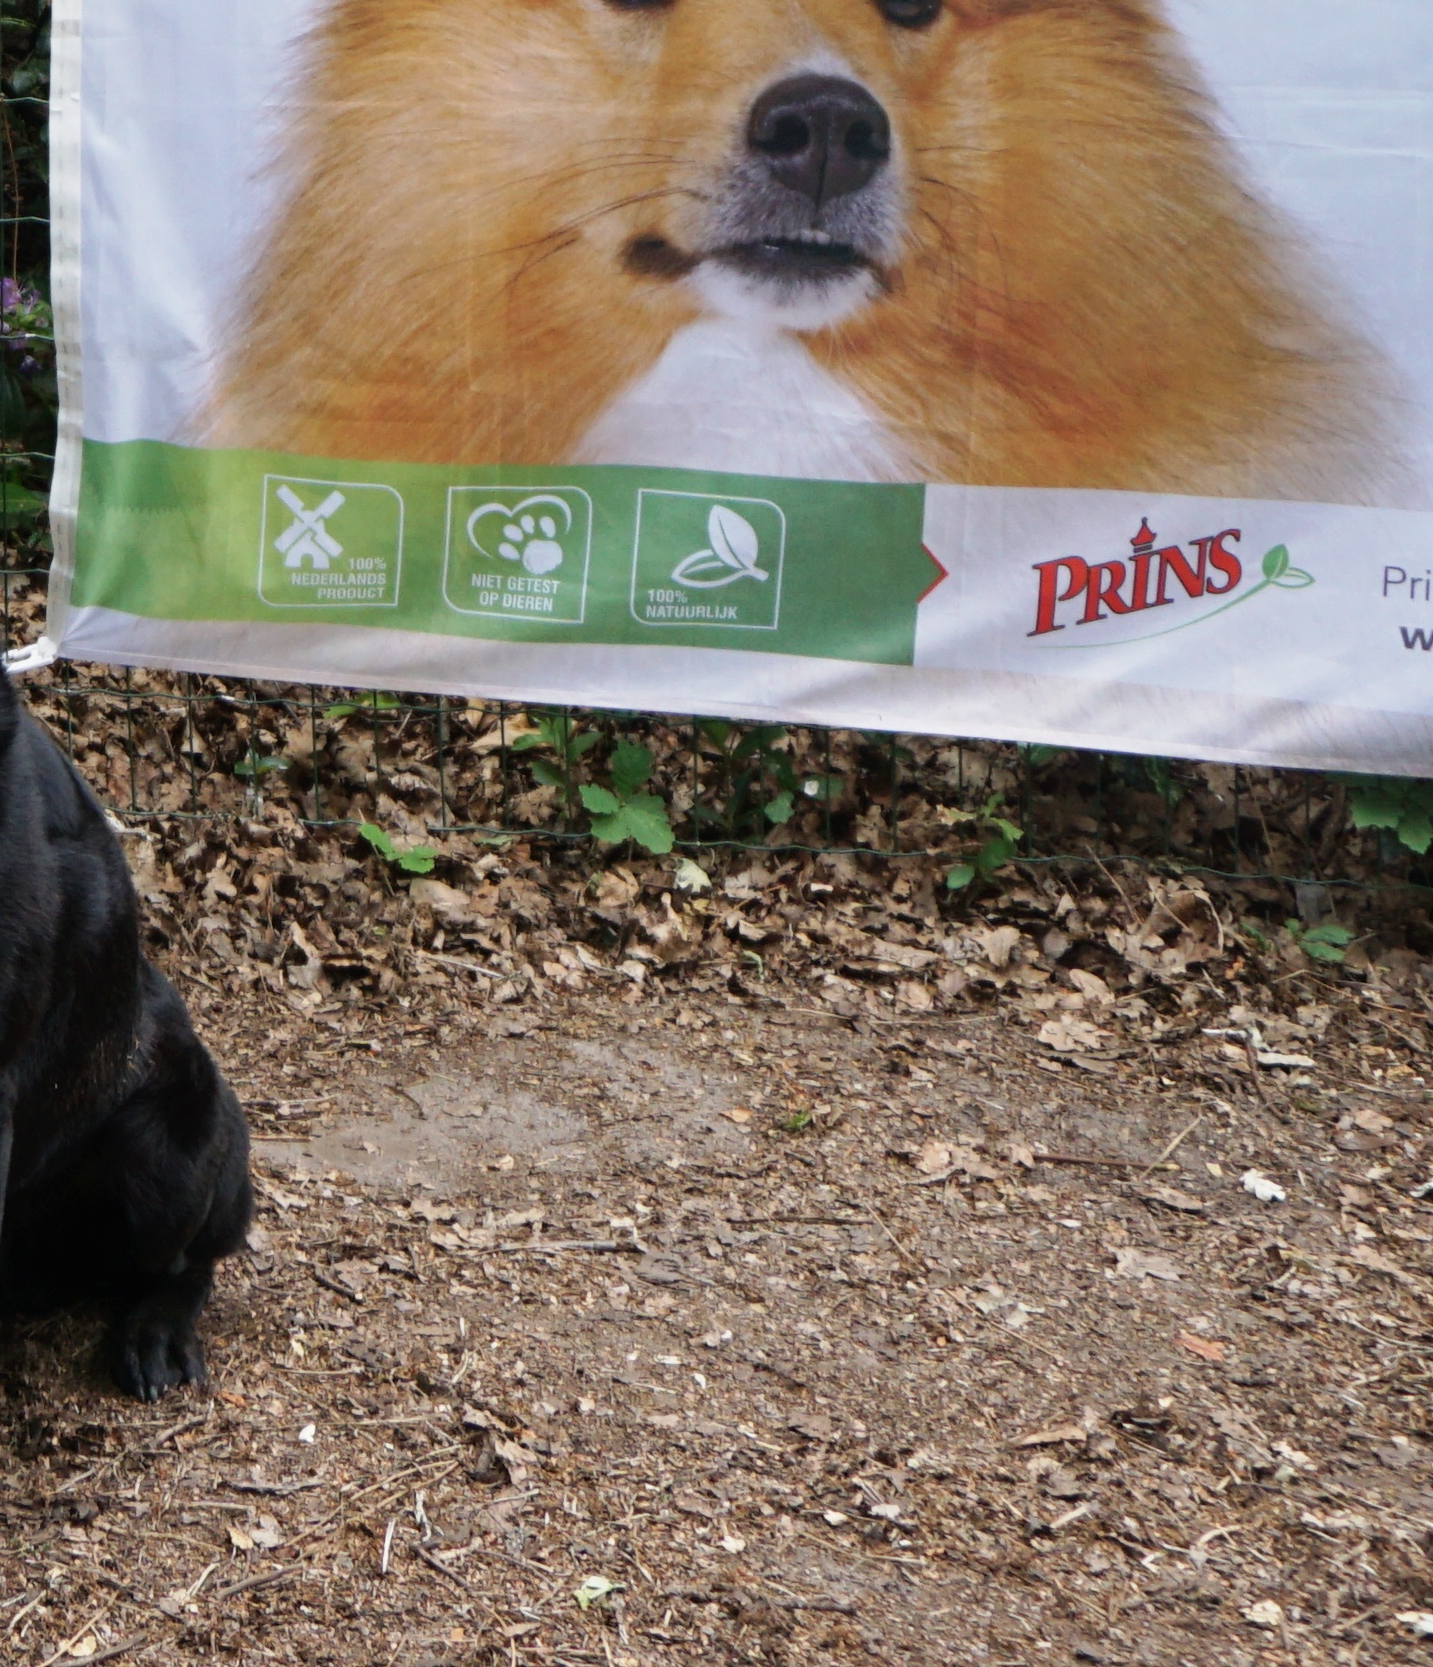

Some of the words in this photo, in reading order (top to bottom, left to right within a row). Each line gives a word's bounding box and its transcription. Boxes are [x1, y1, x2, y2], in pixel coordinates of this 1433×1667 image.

[349, 557, 386, 570] 100%
[292, 573, 386, 585] NEDERLANDS
[471, 573, 503, 589] NIET
[507, 576, 561, 594] GETEST
[1027, 517, 1242, 637] PRINS
[1383, 565, 1432, 601] Pri
[318, 588, 385, 599] PRODUCT
[647, 589, 688, 603] 100%
[479, 591, 499, 606] OP
[503, 593, 553, 612] DIEREN
[646, 605, 738, 619] NATUURLIJK
